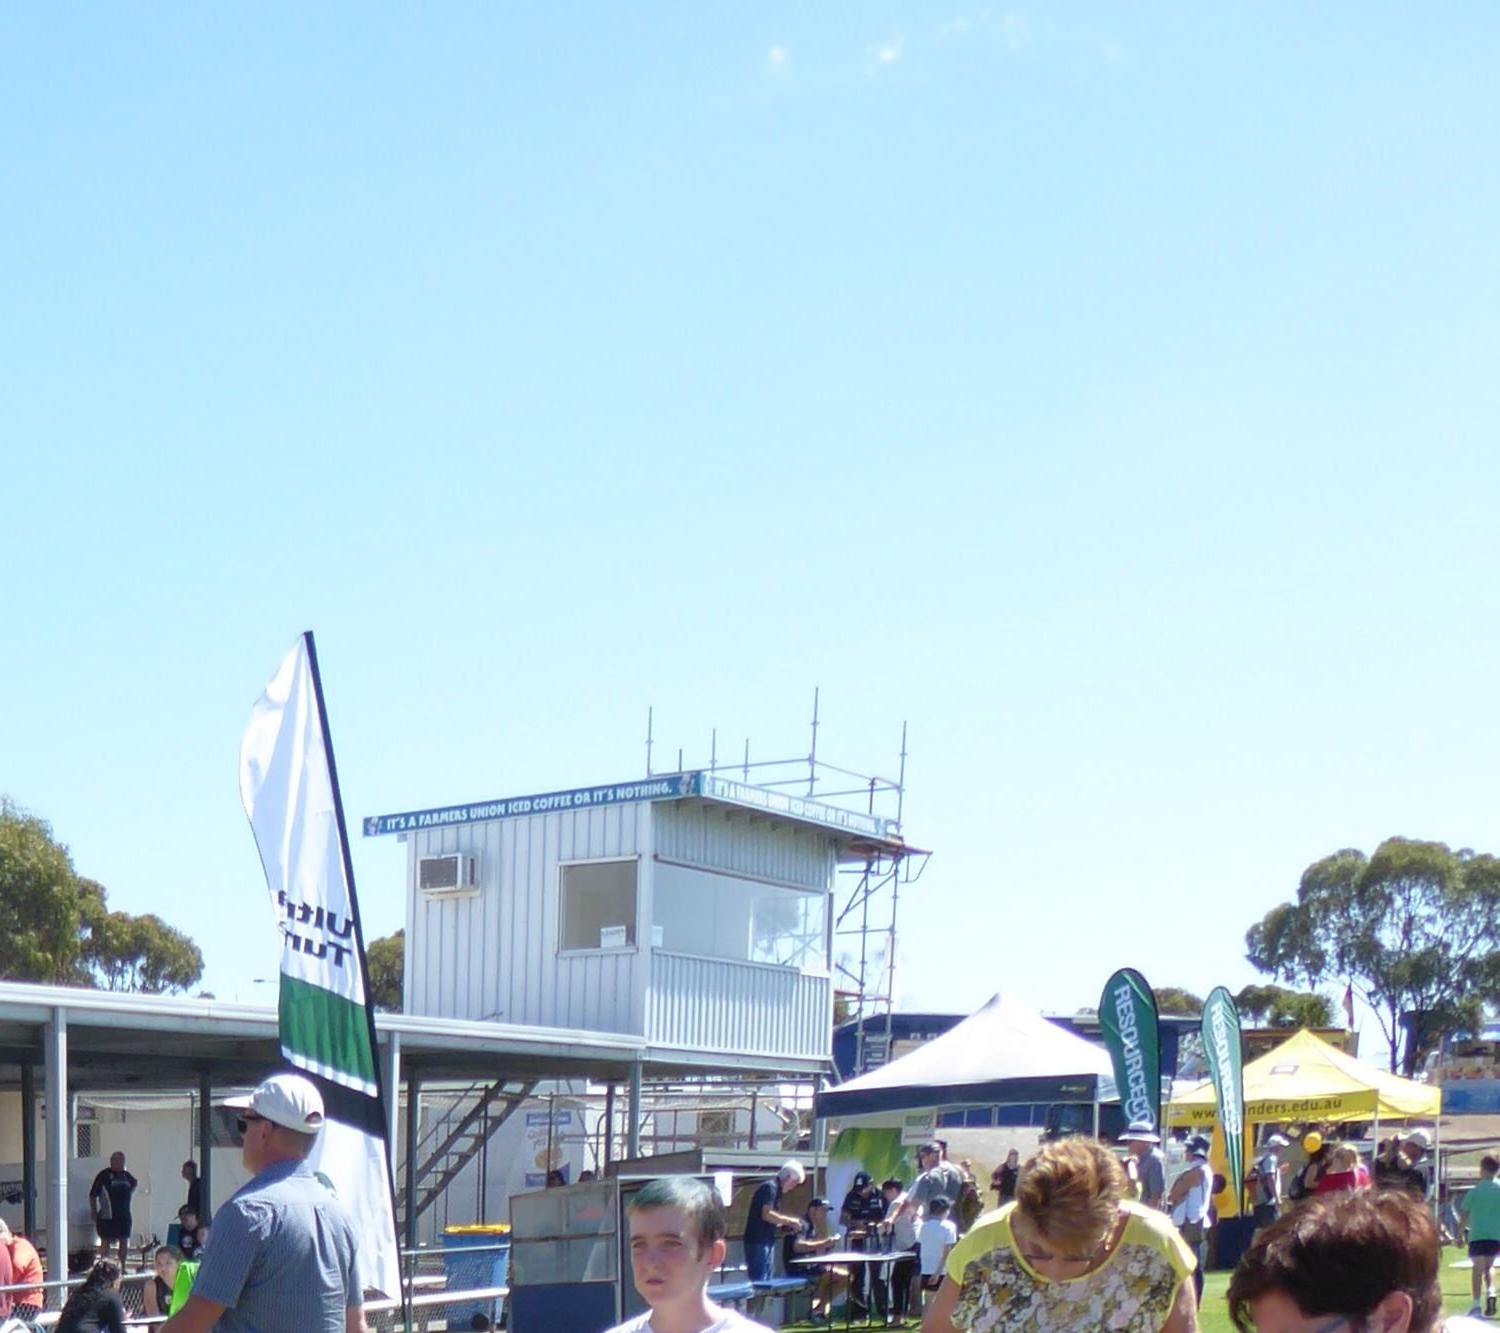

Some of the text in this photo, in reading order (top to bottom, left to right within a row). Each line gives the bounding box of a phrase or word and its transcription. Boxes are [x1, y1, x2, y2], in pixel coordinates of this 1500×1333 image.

[387, 816, 405, 831] IT'S
[408, 816, 417, 829] A
[419, 809, 468, 827] FARMERS
[469, 803, 505, 819] UNION
[508, 799, 531, 814] ICED
[533, 794, 572, 810] COFFEE
[574, 791, 591, 805] OR
[593, 787, 614, 802] IT'S
